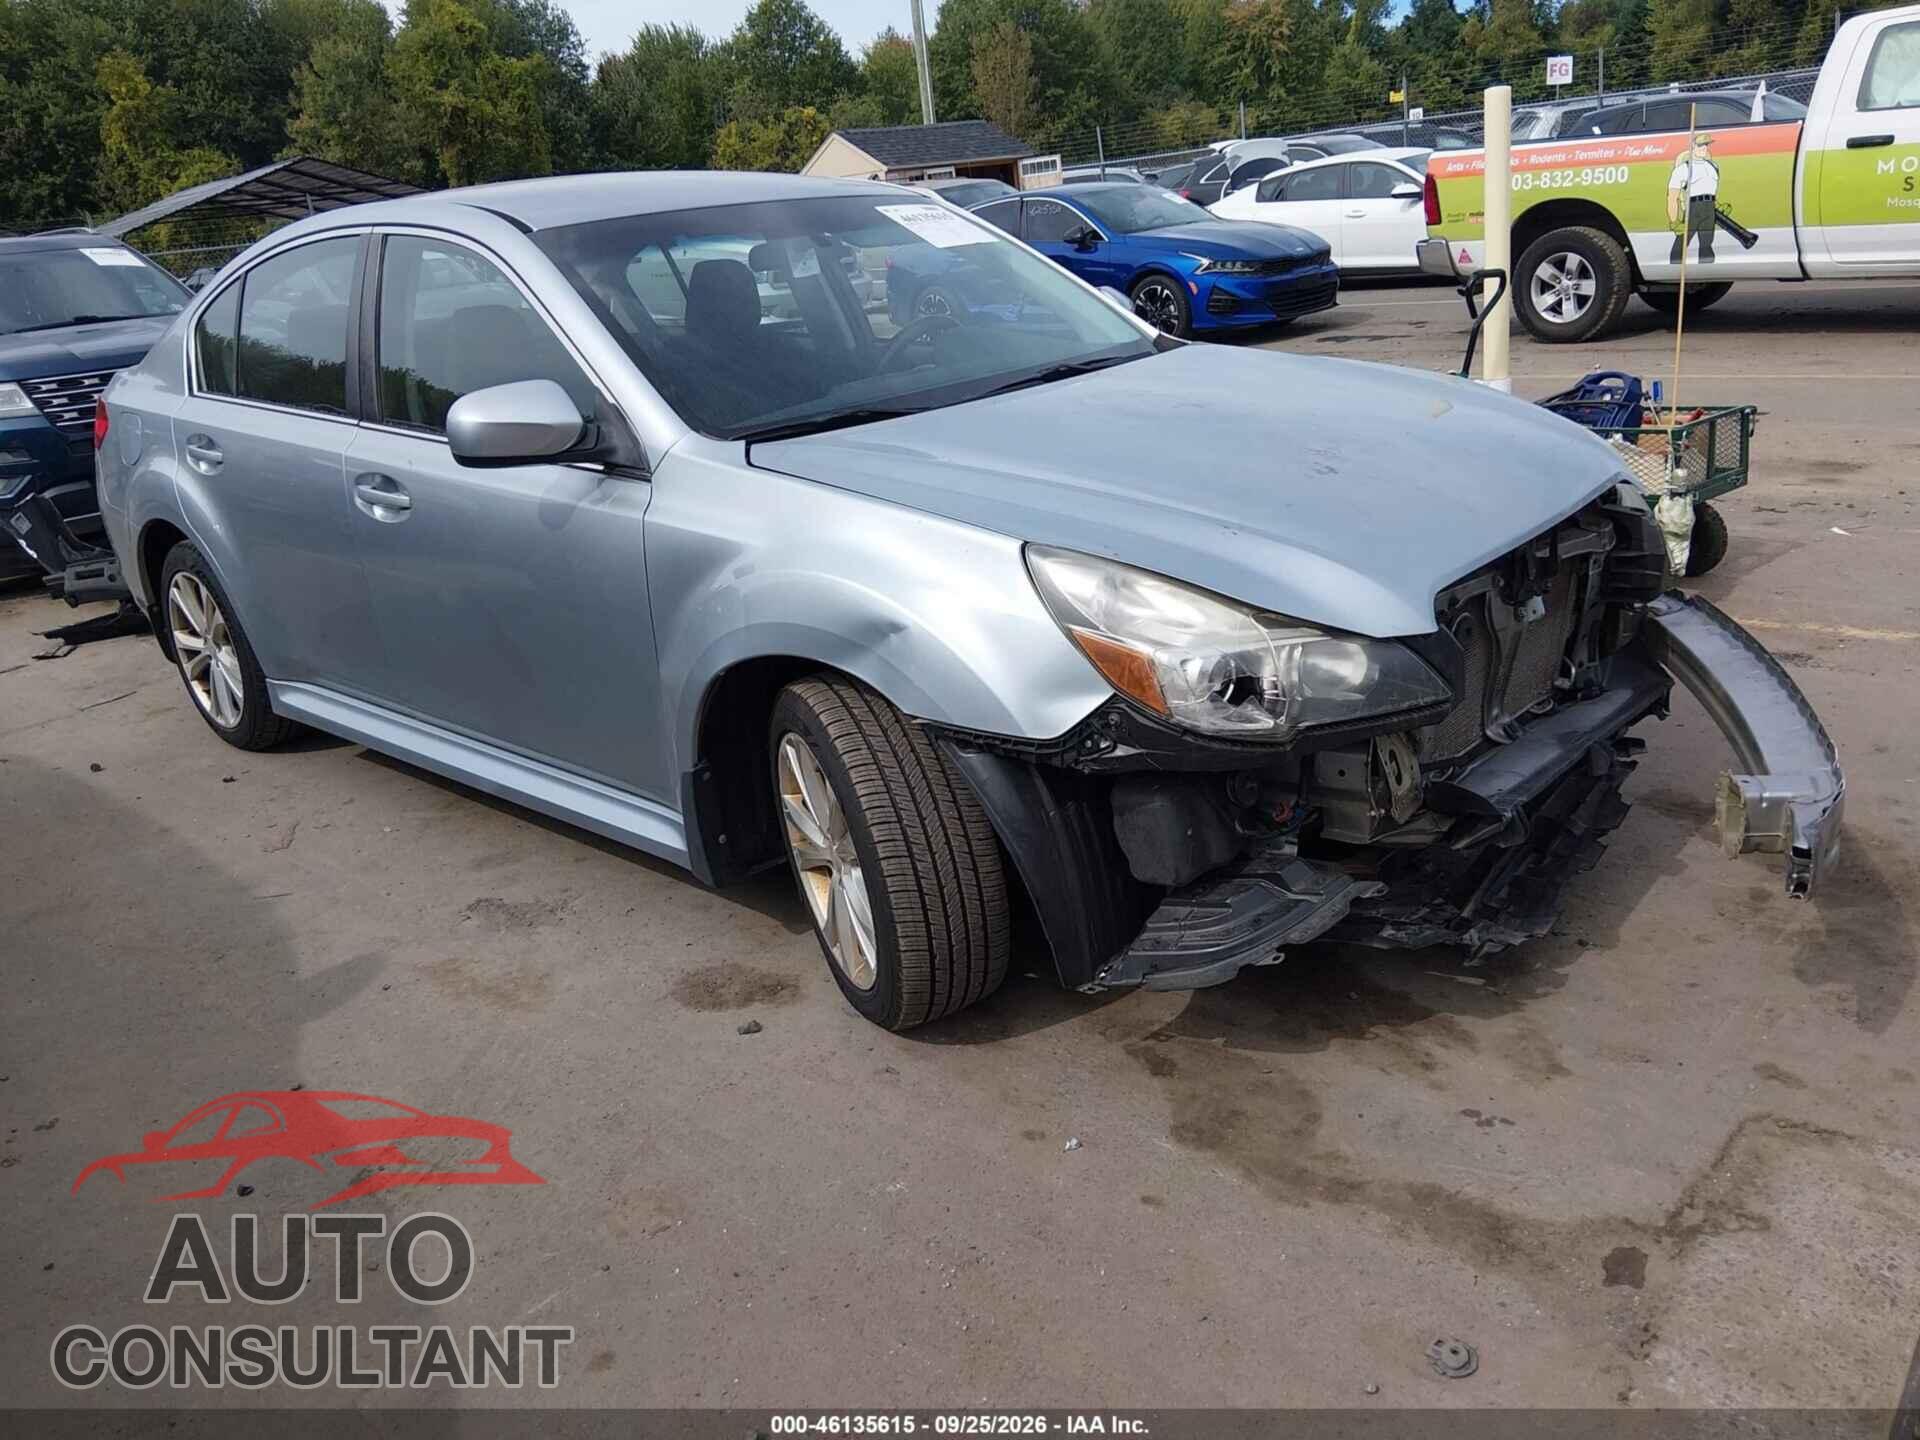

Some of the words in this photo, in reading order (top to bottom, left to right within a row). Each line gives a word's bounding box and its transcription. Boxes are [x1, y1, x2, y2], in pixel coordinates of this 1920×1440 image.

[1549, 62, 1569, 78] FG
[1446, 161, 1464, 173] Ants
[1529, 151, 1566, 165] Rodents
[1575, 147, 1614, 160] Termites
[1512, 166, 1629, 190] 03-832-9500
